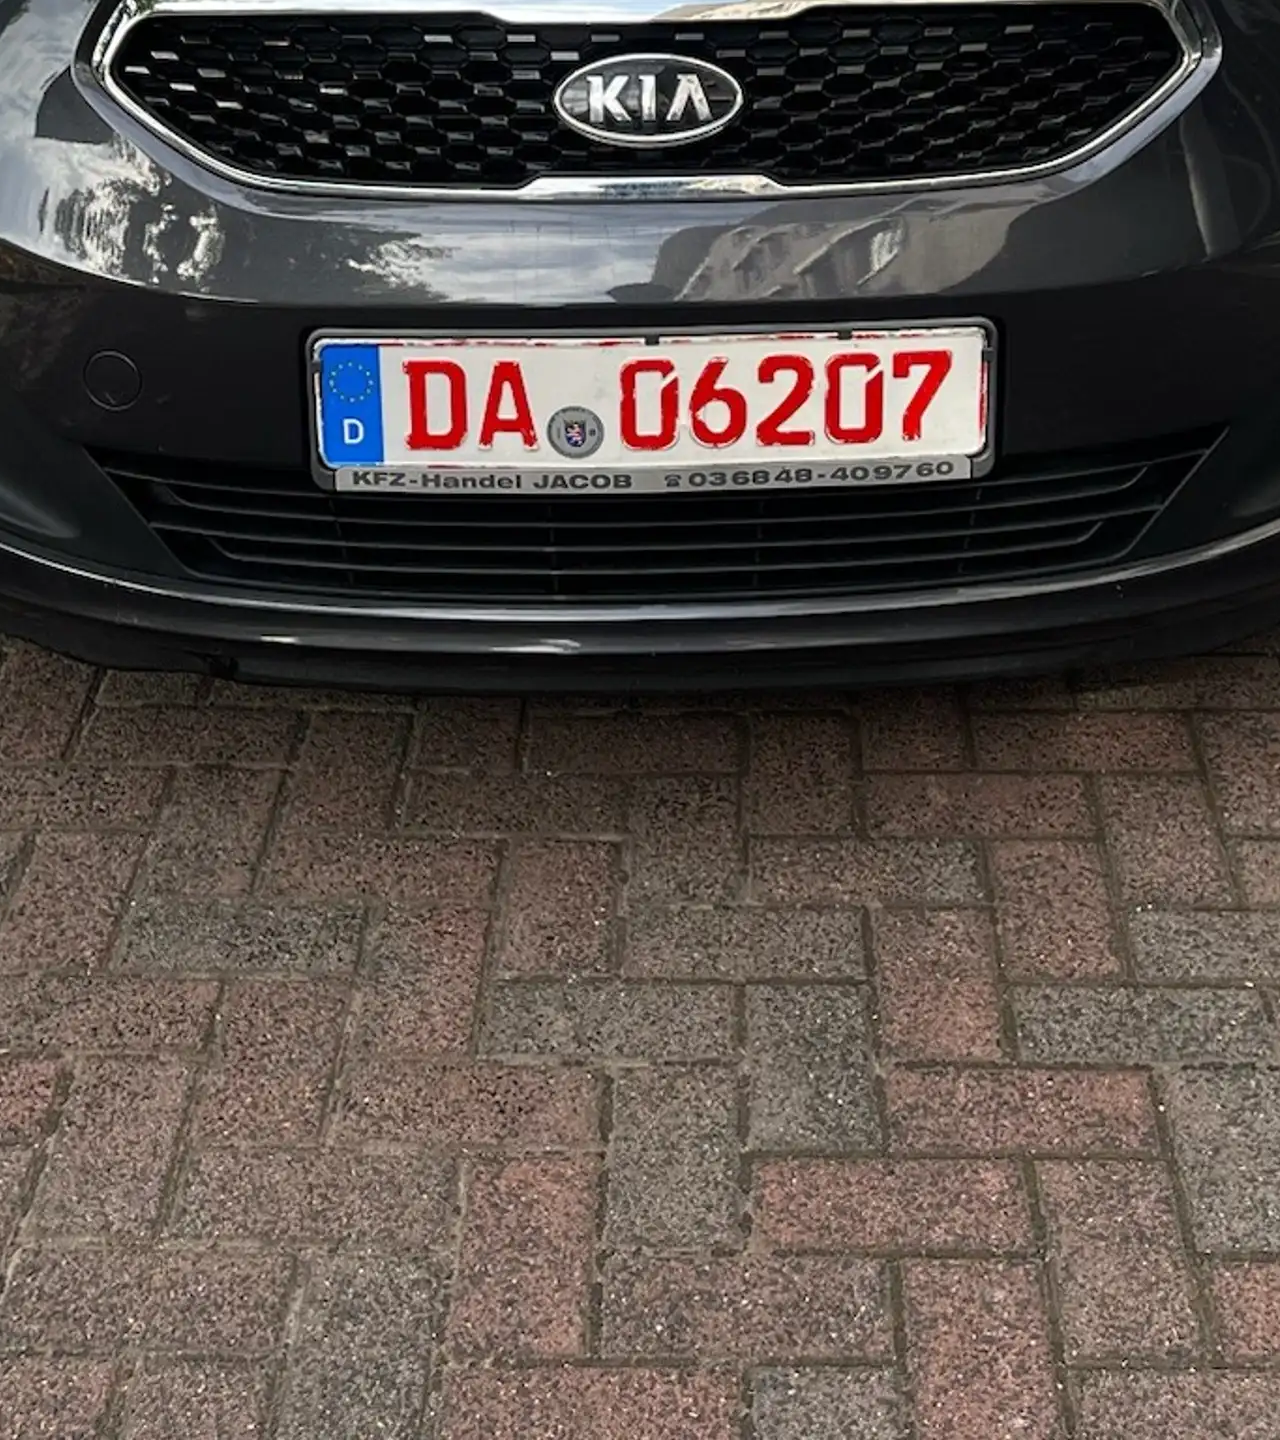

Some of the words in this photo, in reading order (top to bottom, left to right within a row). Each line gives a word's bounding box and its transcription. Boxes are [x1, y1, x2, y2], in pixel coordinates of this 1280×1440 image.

[586, 74, 713, 122] KIA
[402, 359, 540, 452] DA
[620, 349, 953, 451] 06207
[343, 418, 366, 445] D
[351, 469, 522, 490] KFZ-Handel
[533, 474, 633, 490] JACOB
[688, 460, 955, 488] 036848-409760
